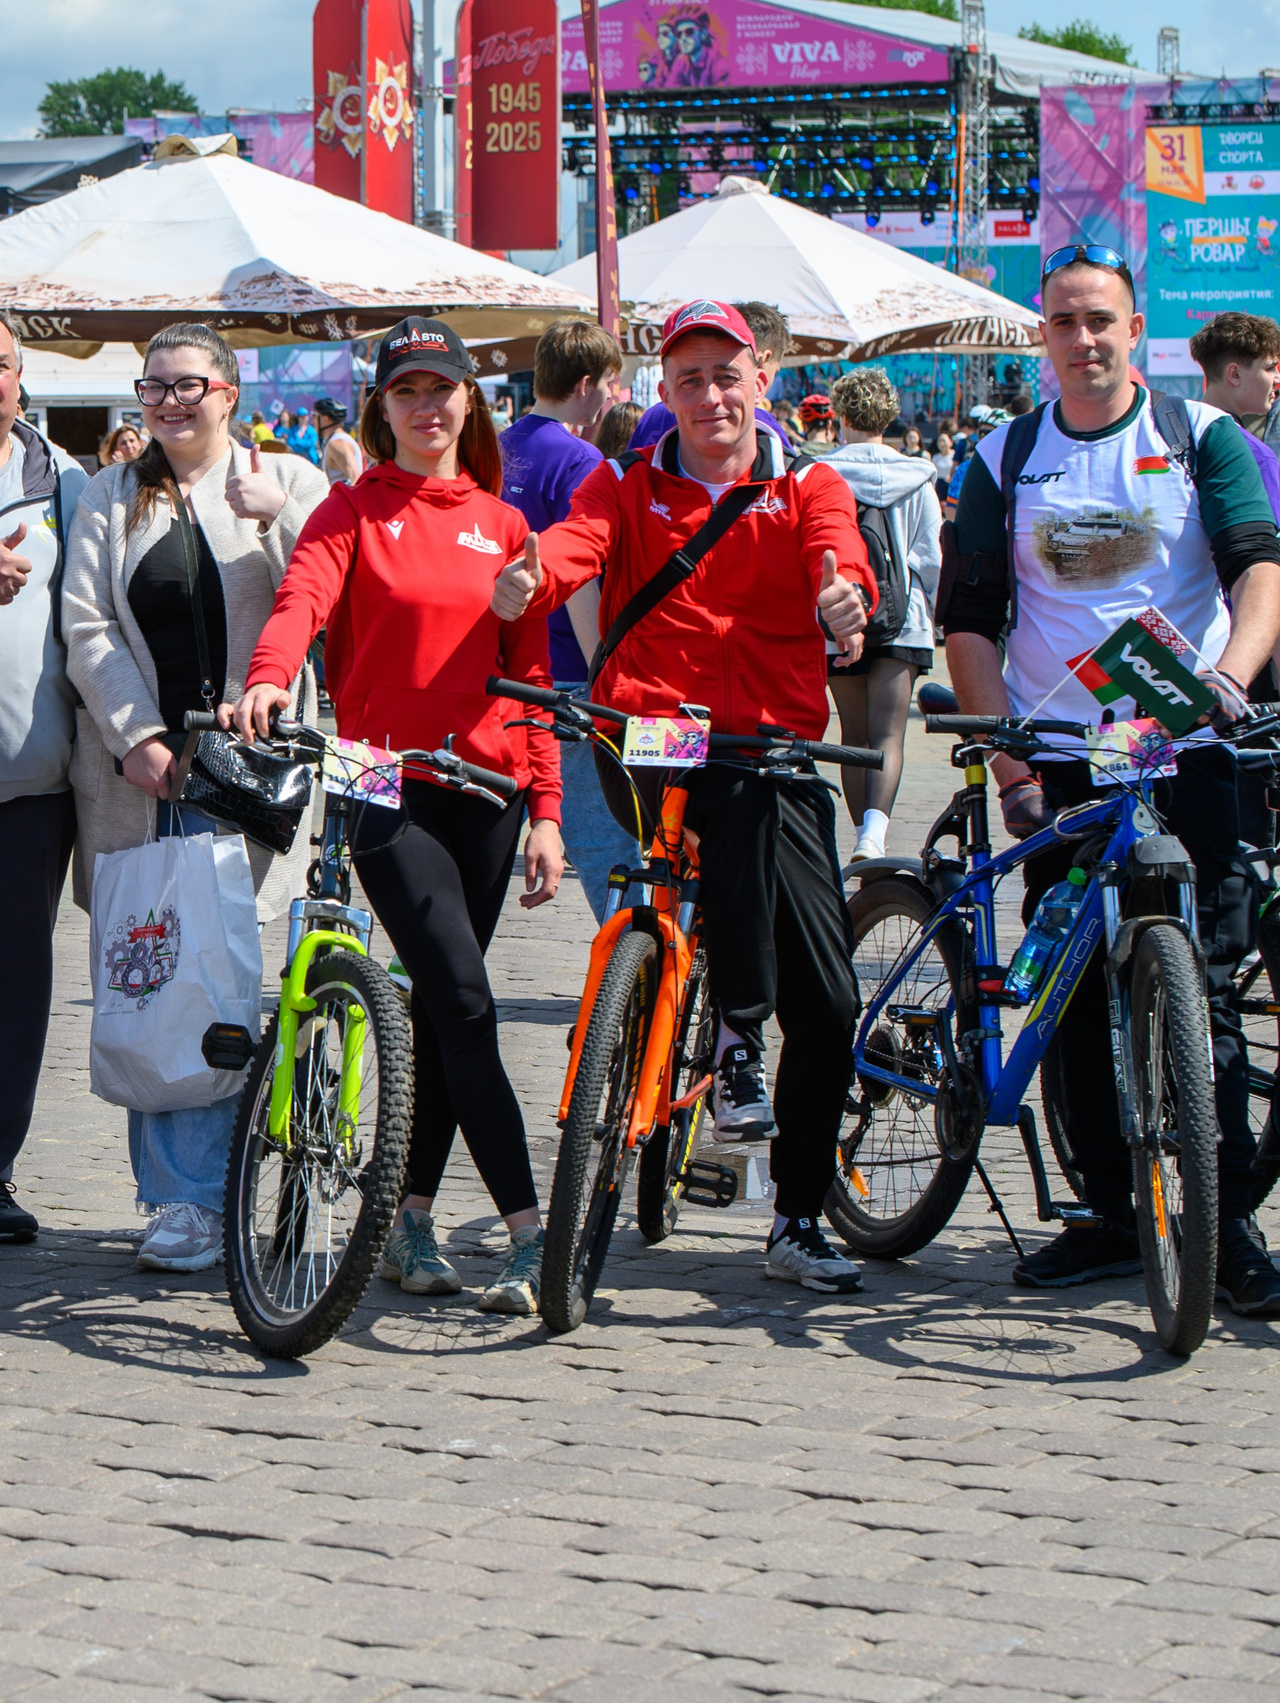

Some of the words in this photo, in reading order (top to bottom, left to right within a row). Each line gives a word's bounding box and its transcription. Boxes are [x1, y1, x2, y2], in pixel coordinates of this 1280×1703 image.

[473, 26, 556, 77] Победа
[771, 40, 841, 63] VIVA
[488, 82, 541, 114] 1945
[486, 122, 542, 153] 2025
[1160, 133, 1186, 161] 31
[1219, 151, 1264, 164] СПОРТА
[1184, 217, 1251, 237] ПЕРШЫ
[1190, 243, 1246, 262] РОВАР
[1160, 288, 1188, 300] Тема
[1120, 642, 1193, 706] VOLAT
[629, 749, 661, 757] 11905
[1036, 917, 1102, 1040] AUTHOR
